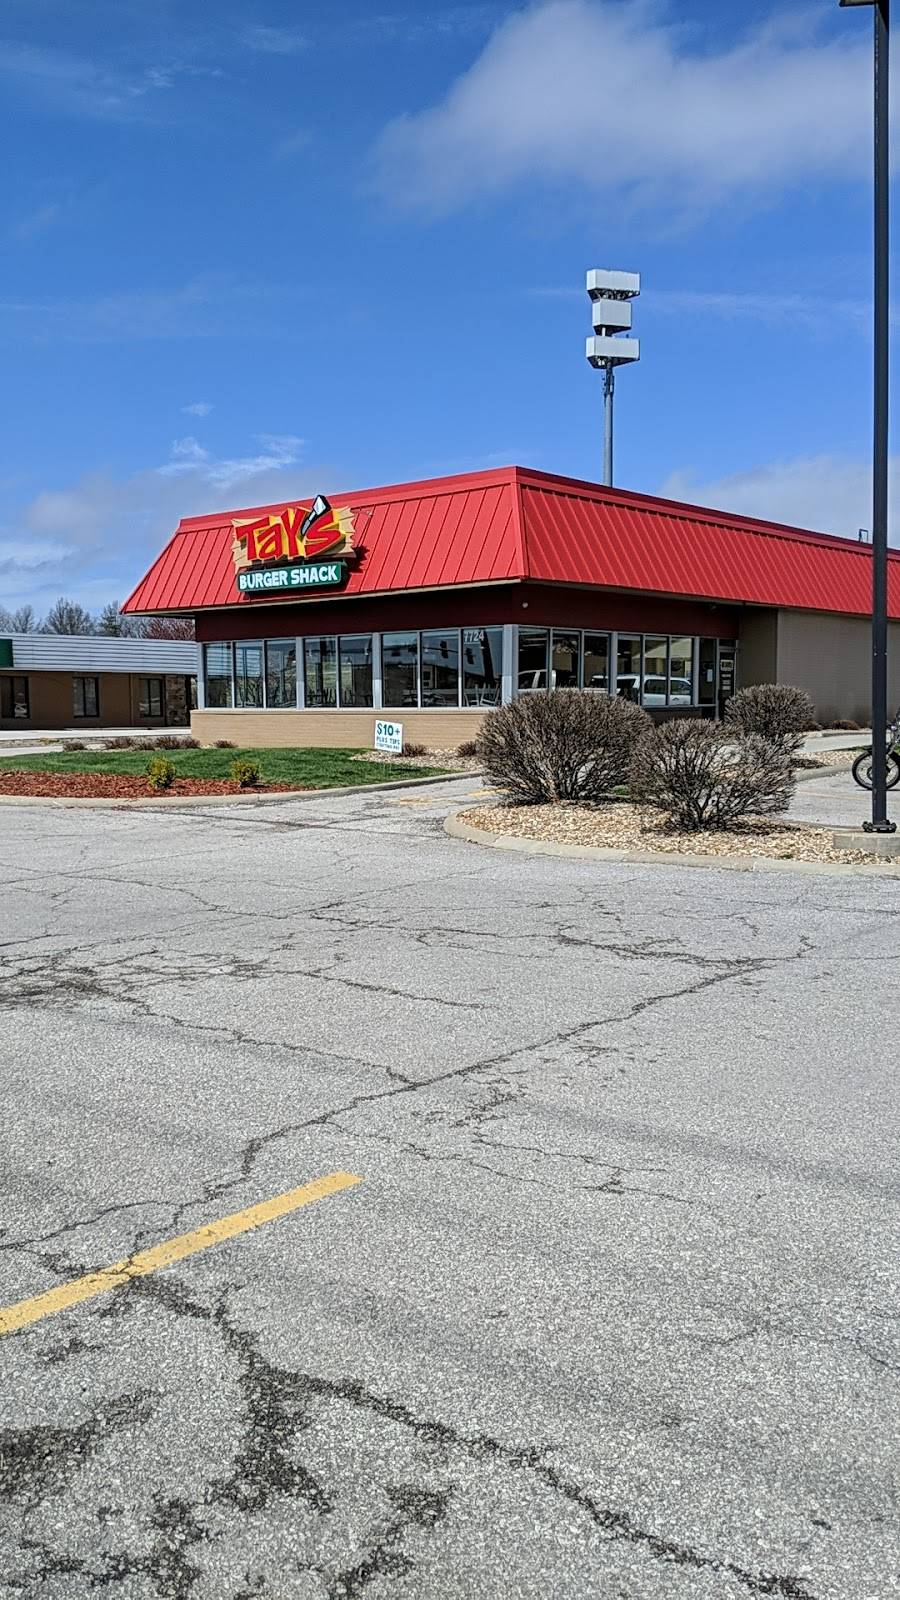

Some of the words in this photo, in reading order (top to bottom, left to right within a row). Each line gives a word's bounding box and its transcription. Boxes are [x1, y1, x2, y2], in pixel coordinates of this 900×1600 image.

[239, 571, 288, 589] BURGER
[290, 565, 338, 585] SHACK
[464, 630, 485, 643] 7724
